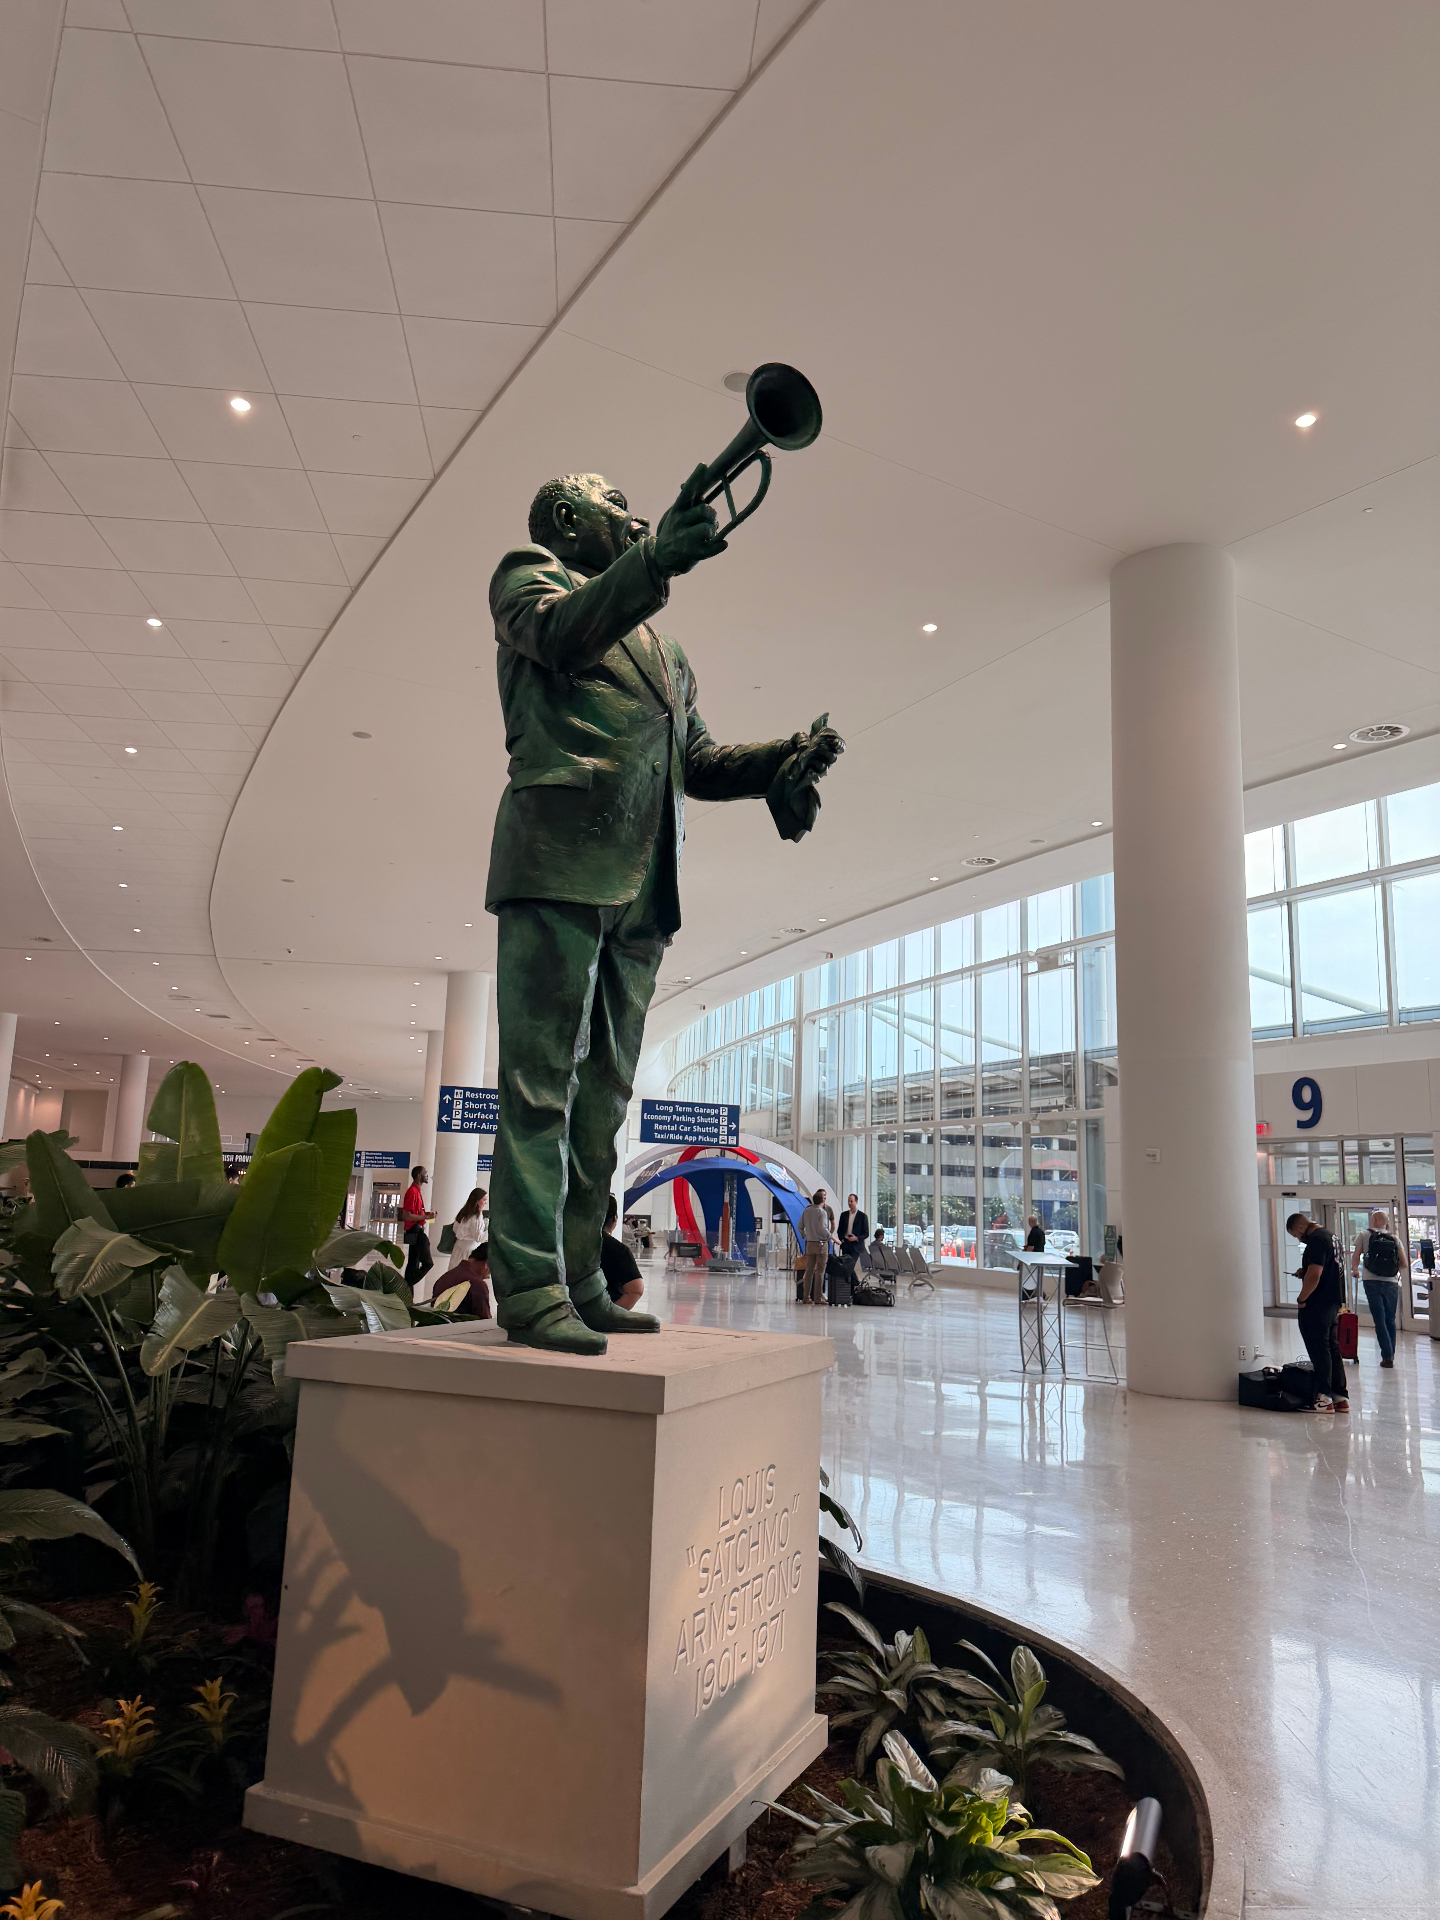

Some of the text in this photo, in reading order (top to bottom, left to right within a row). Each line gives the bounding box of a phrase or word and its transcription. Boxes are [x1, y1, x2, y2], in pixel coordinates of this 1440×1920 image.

[464, 1101, 487, 1110] Short
[1291, 1076, 1323, 1129] 9
[655, 1103, 673, 1112] Long
[675, 1104, 692, 1112] Term
[694, 1106, 719, 1115] Garage
[463, 1111, 494, 1120] Surface
[643, 1113, 671, 1122] Economy
[672, 1114, 695, 1124] Parking
[696, 1116, 719, 1124] Shuttle
[463, 1121, 498, 1131] Off-Airp
[654, 1123, 719, 1133] Rental Car Shuttle
[653, 1132, 718, 1143] Taxi/Ride App Pickup
[718, 1463, 776, 1534] LOUIS
[685, 1493, 800, 1599] "SATCHMO"
[673, 1550, 802, 1675] ARMSTRONG
